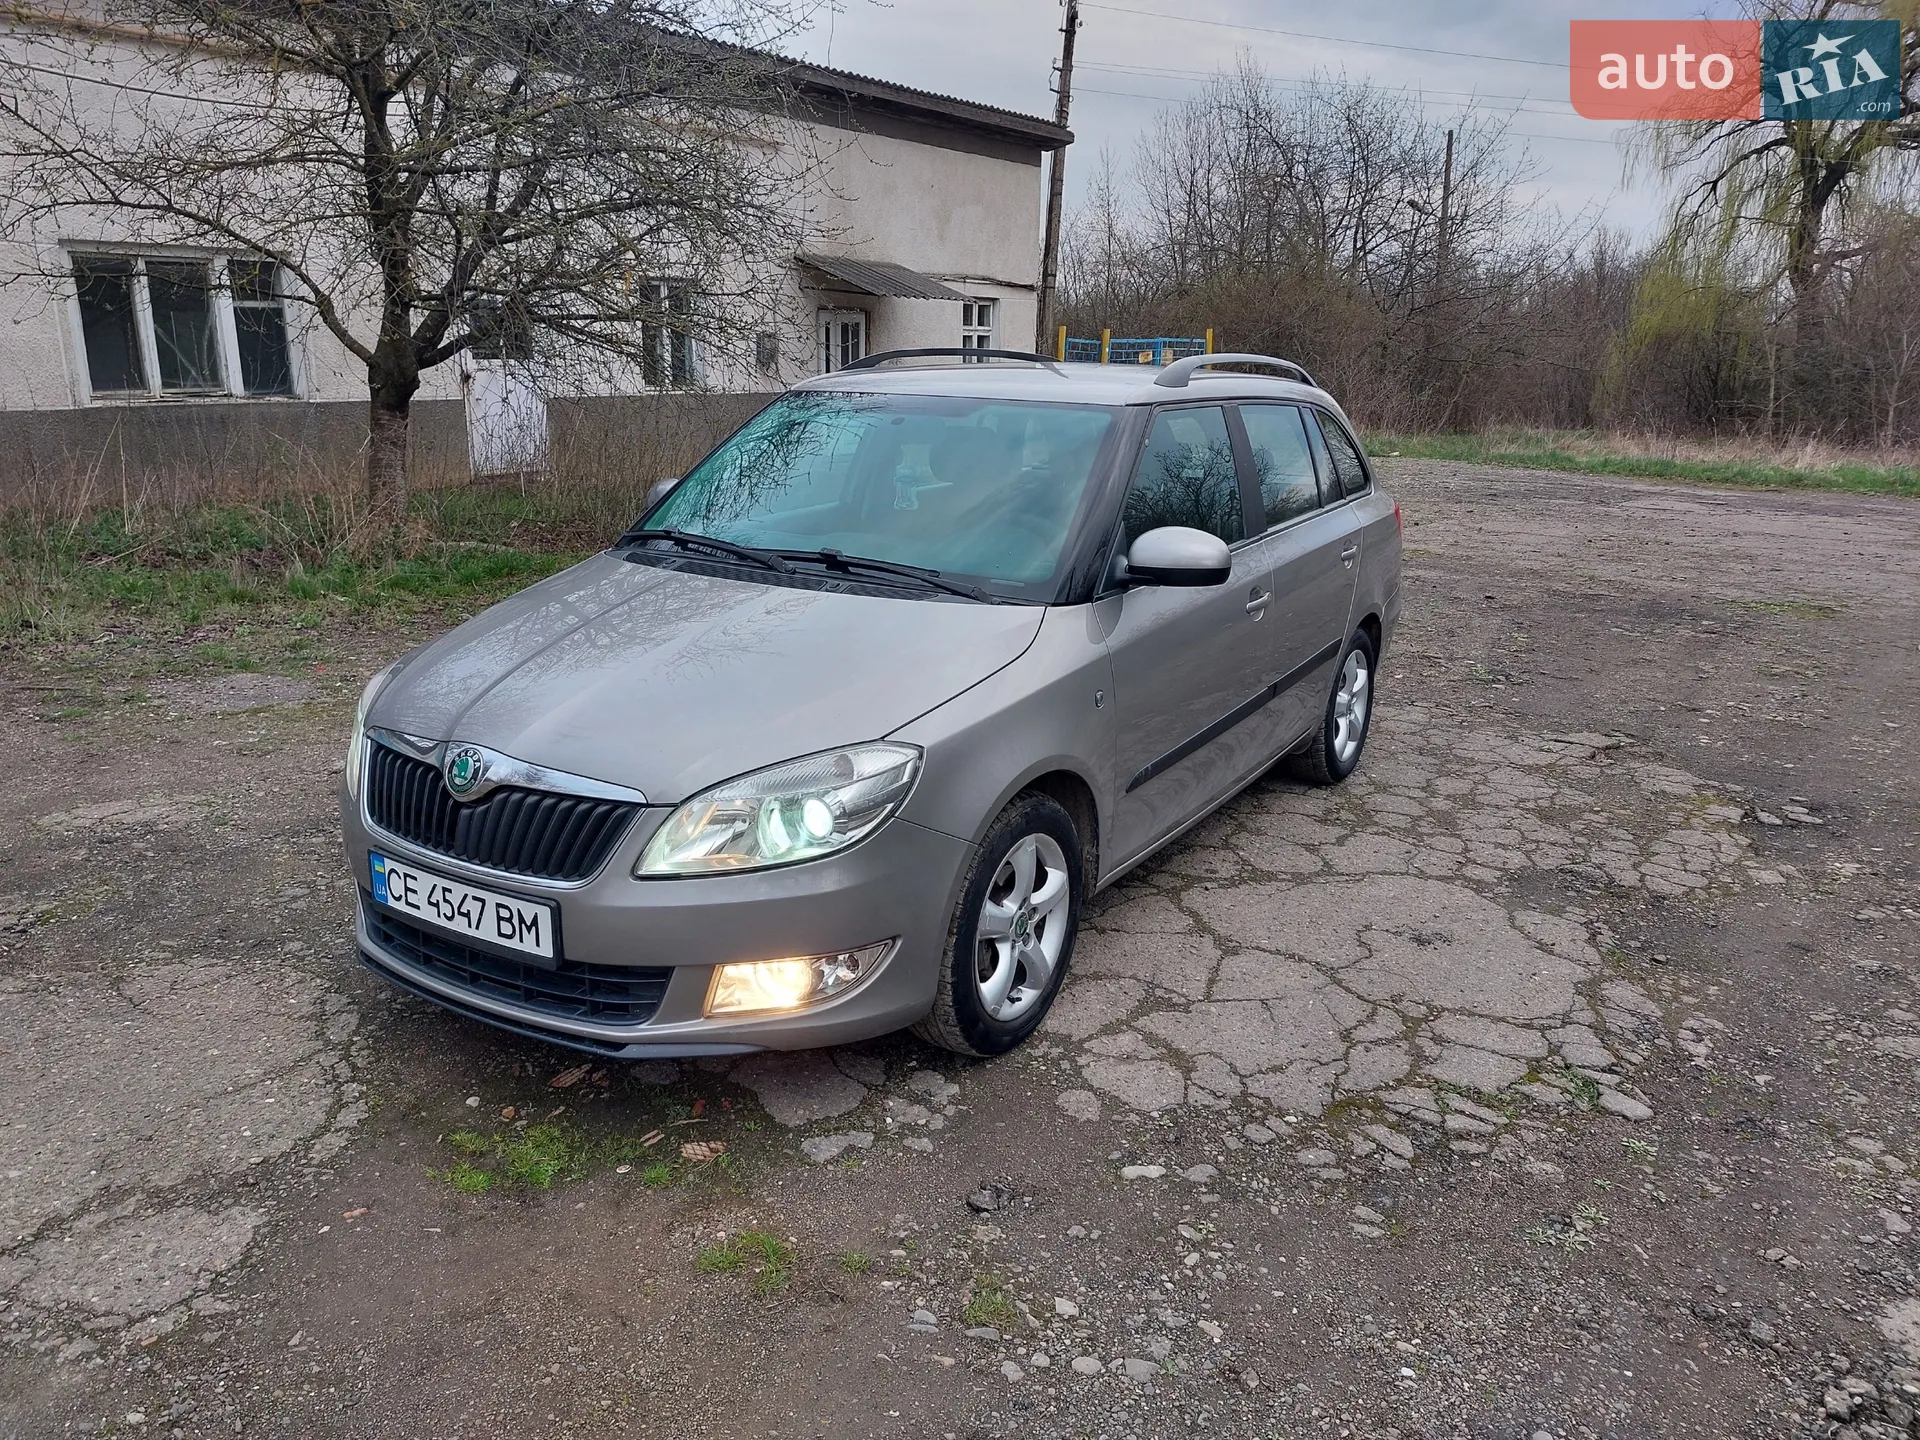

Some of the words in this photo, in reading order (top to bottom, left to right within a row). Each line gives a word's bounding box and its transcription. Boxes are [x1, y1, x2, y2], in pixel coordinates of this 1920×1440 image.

[376, 884, 387, 896] UA
[387, 867, 421, 911] CE
[427, 883, 486, 931] 4547
[495, 901, 541, 948] BM
